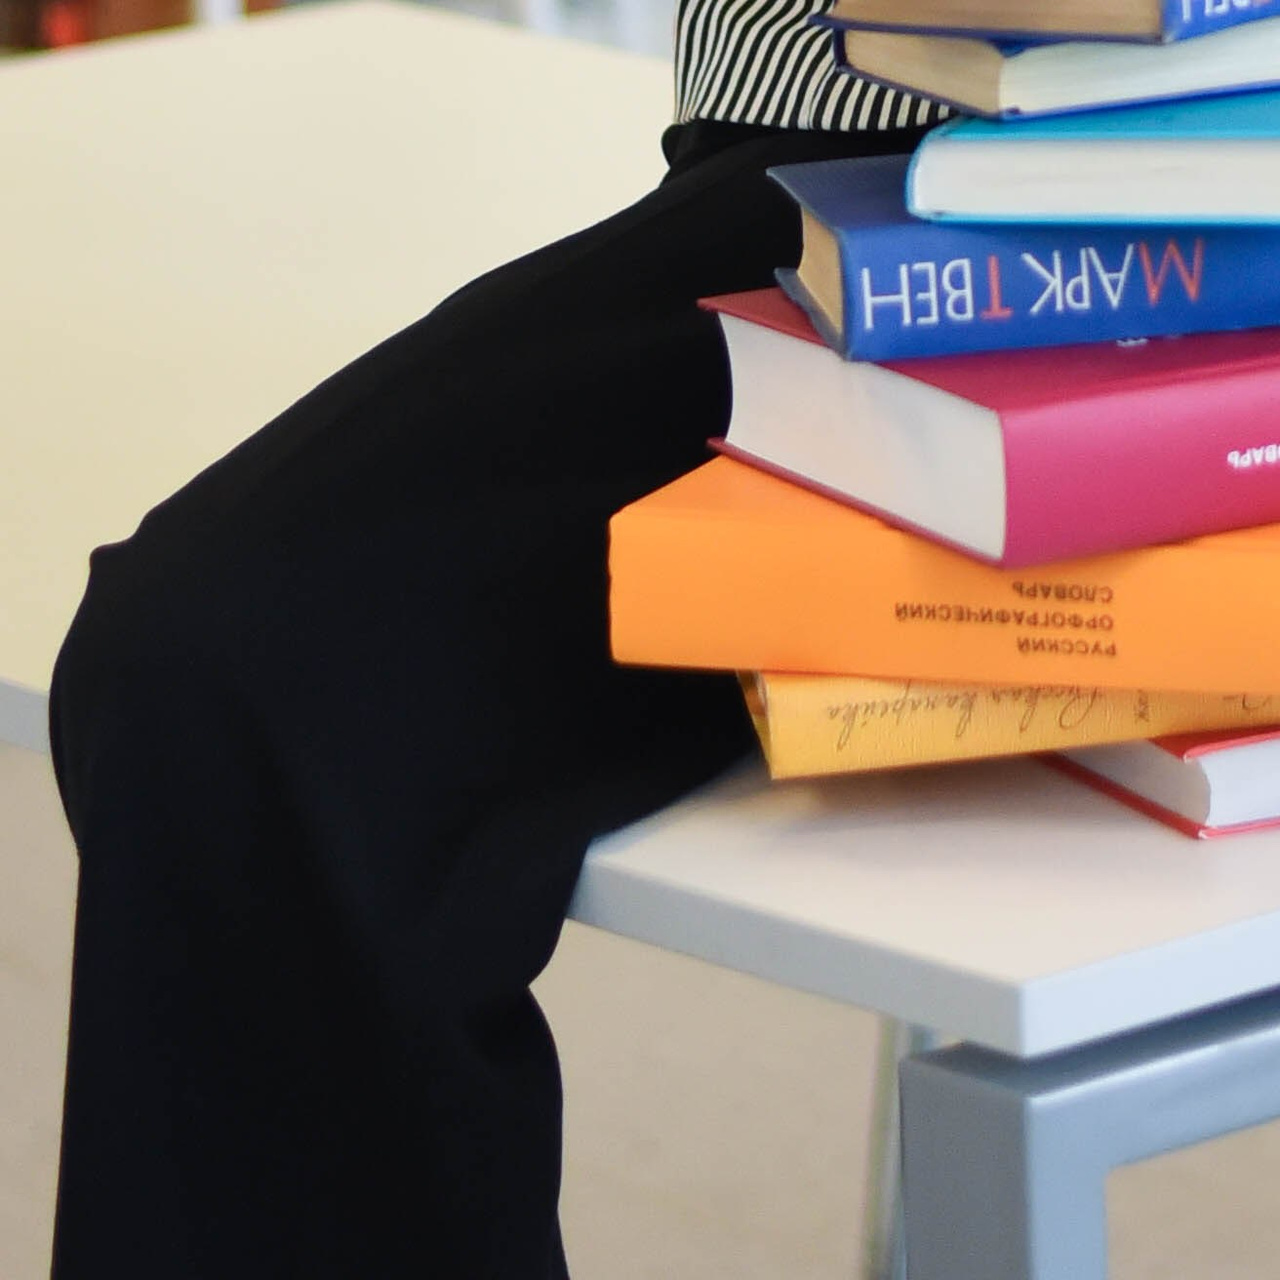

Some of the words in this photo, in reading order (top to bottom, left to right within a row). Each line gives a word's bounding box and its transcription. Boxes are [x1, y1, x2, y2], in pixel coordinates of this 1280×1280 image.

[1021, 238, 1203, 315] МАРК
[862, 254, 1011, 329] ТВЕН
[1012, 581, 1114, 604] СЛОВАРЬ
[895, 602, 1115, 631] ОРФОГРАФИЧЕСКИЙ
[1017, 636, 1117, 657] РУССКИЙ
